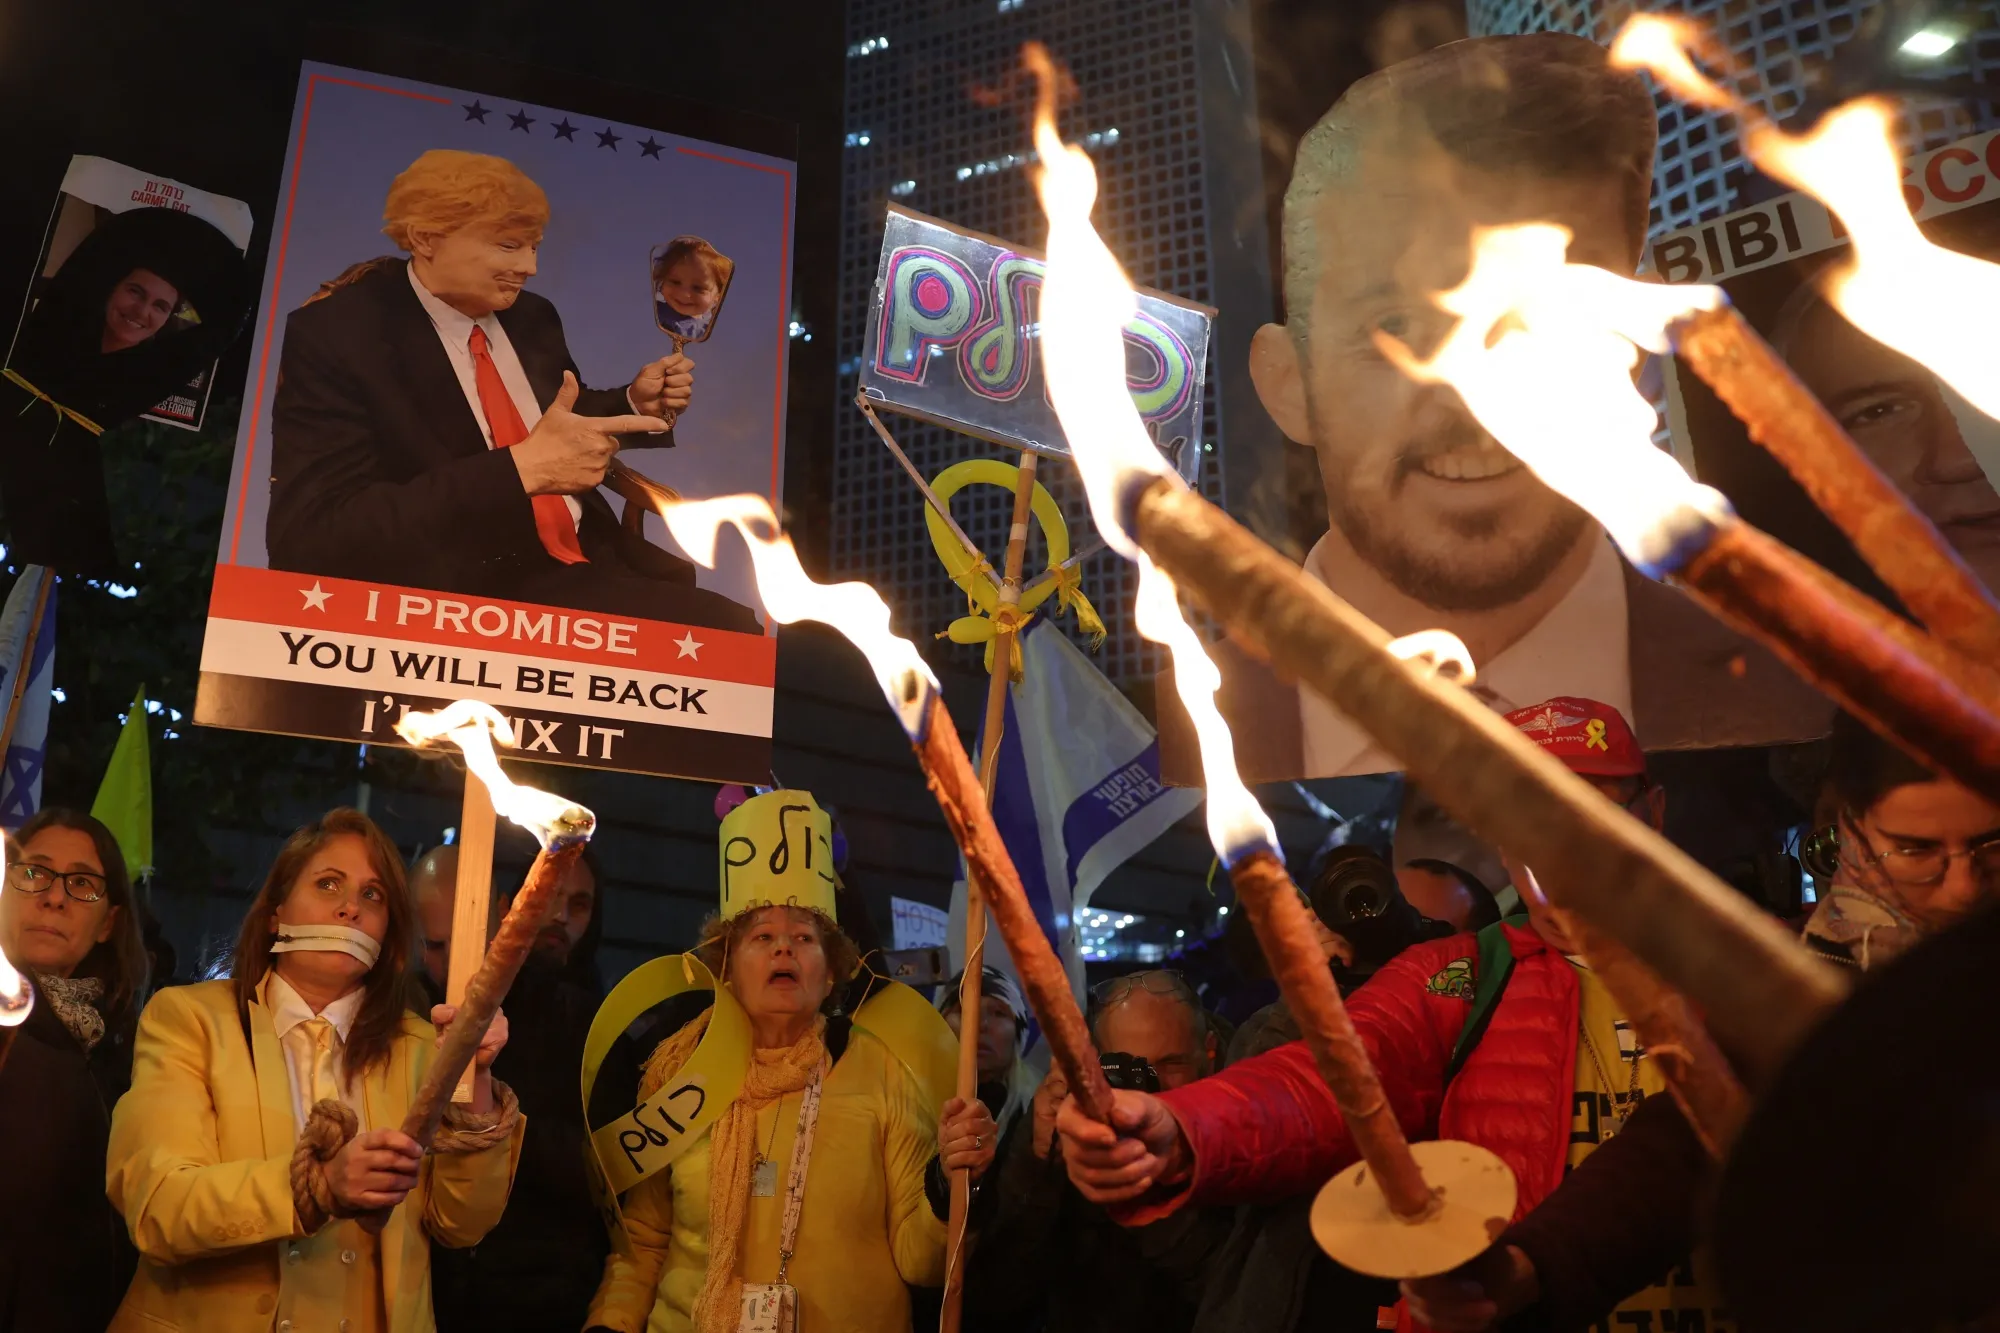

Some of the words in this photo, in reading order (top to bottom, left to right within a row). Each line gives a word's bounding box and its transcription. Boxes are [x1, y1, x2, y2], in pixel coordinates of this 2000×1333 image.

[131, 190, 169, 208] CARMEL
[1652, 201, 1802, 284] BIBI
[168, 402, 196, 418] FORUM
[365, 590, 380, 622] I
[396, 594, 638, 656] PROMISE
[279, 631, 376, 672] YOU
[390, 651, 502, 690] WILL
[515, 666, 575, 699] BE
[587, 674, 709, 715] BACK
[577, 724, 625, 760] IT
[1092, 762, 1149, 801] חופשי
[1108, 777, 1161, 818] בארצנו
[619, 1084, 705, 1174] כולם
